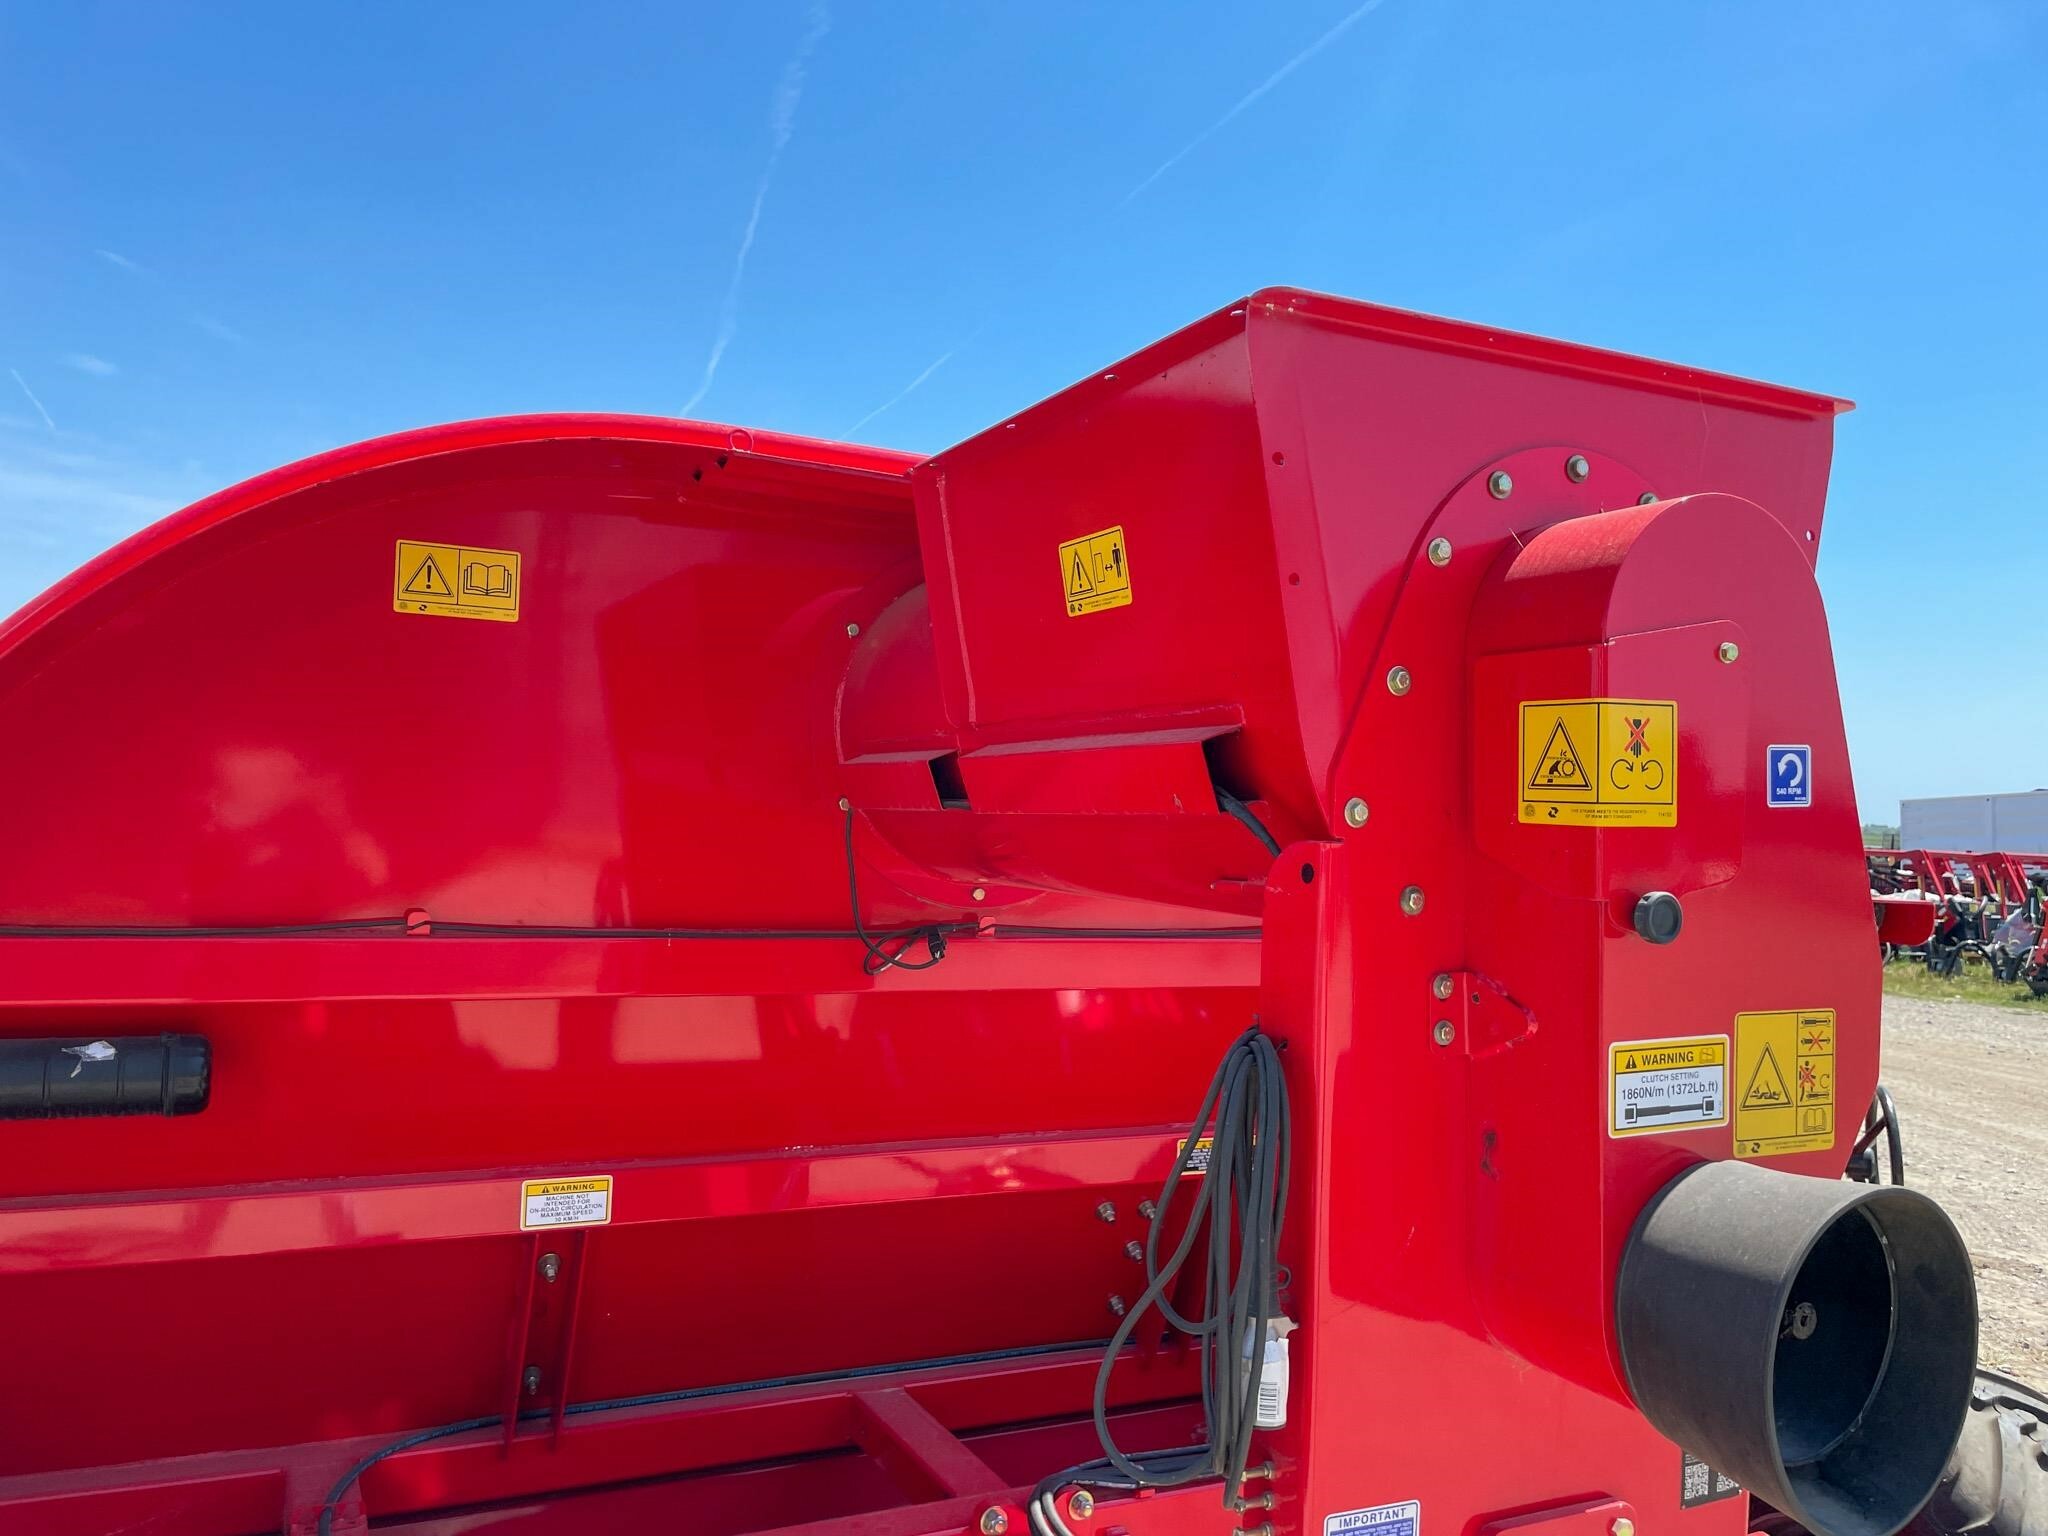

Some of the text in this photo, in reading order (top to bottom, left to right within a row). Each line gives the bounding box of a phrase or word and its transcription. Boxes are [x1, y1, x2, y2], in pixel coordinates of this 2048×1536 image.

[1776, 787, 1802, 795] 540 RPM
[1641, 1051, 1694, 1066] WARNING
[1641, 1071, 1699, 1084] CLUTCH SETTING
[1622, 1080, 1719, 1100] 1860N/m (1372Lb.ft)
[553, 1183, 595, 1192] WARNING
[561, 1203, 603, 1211] CIRCULATION
[1339, 1508, 1407, 1528] IMPORTANT
